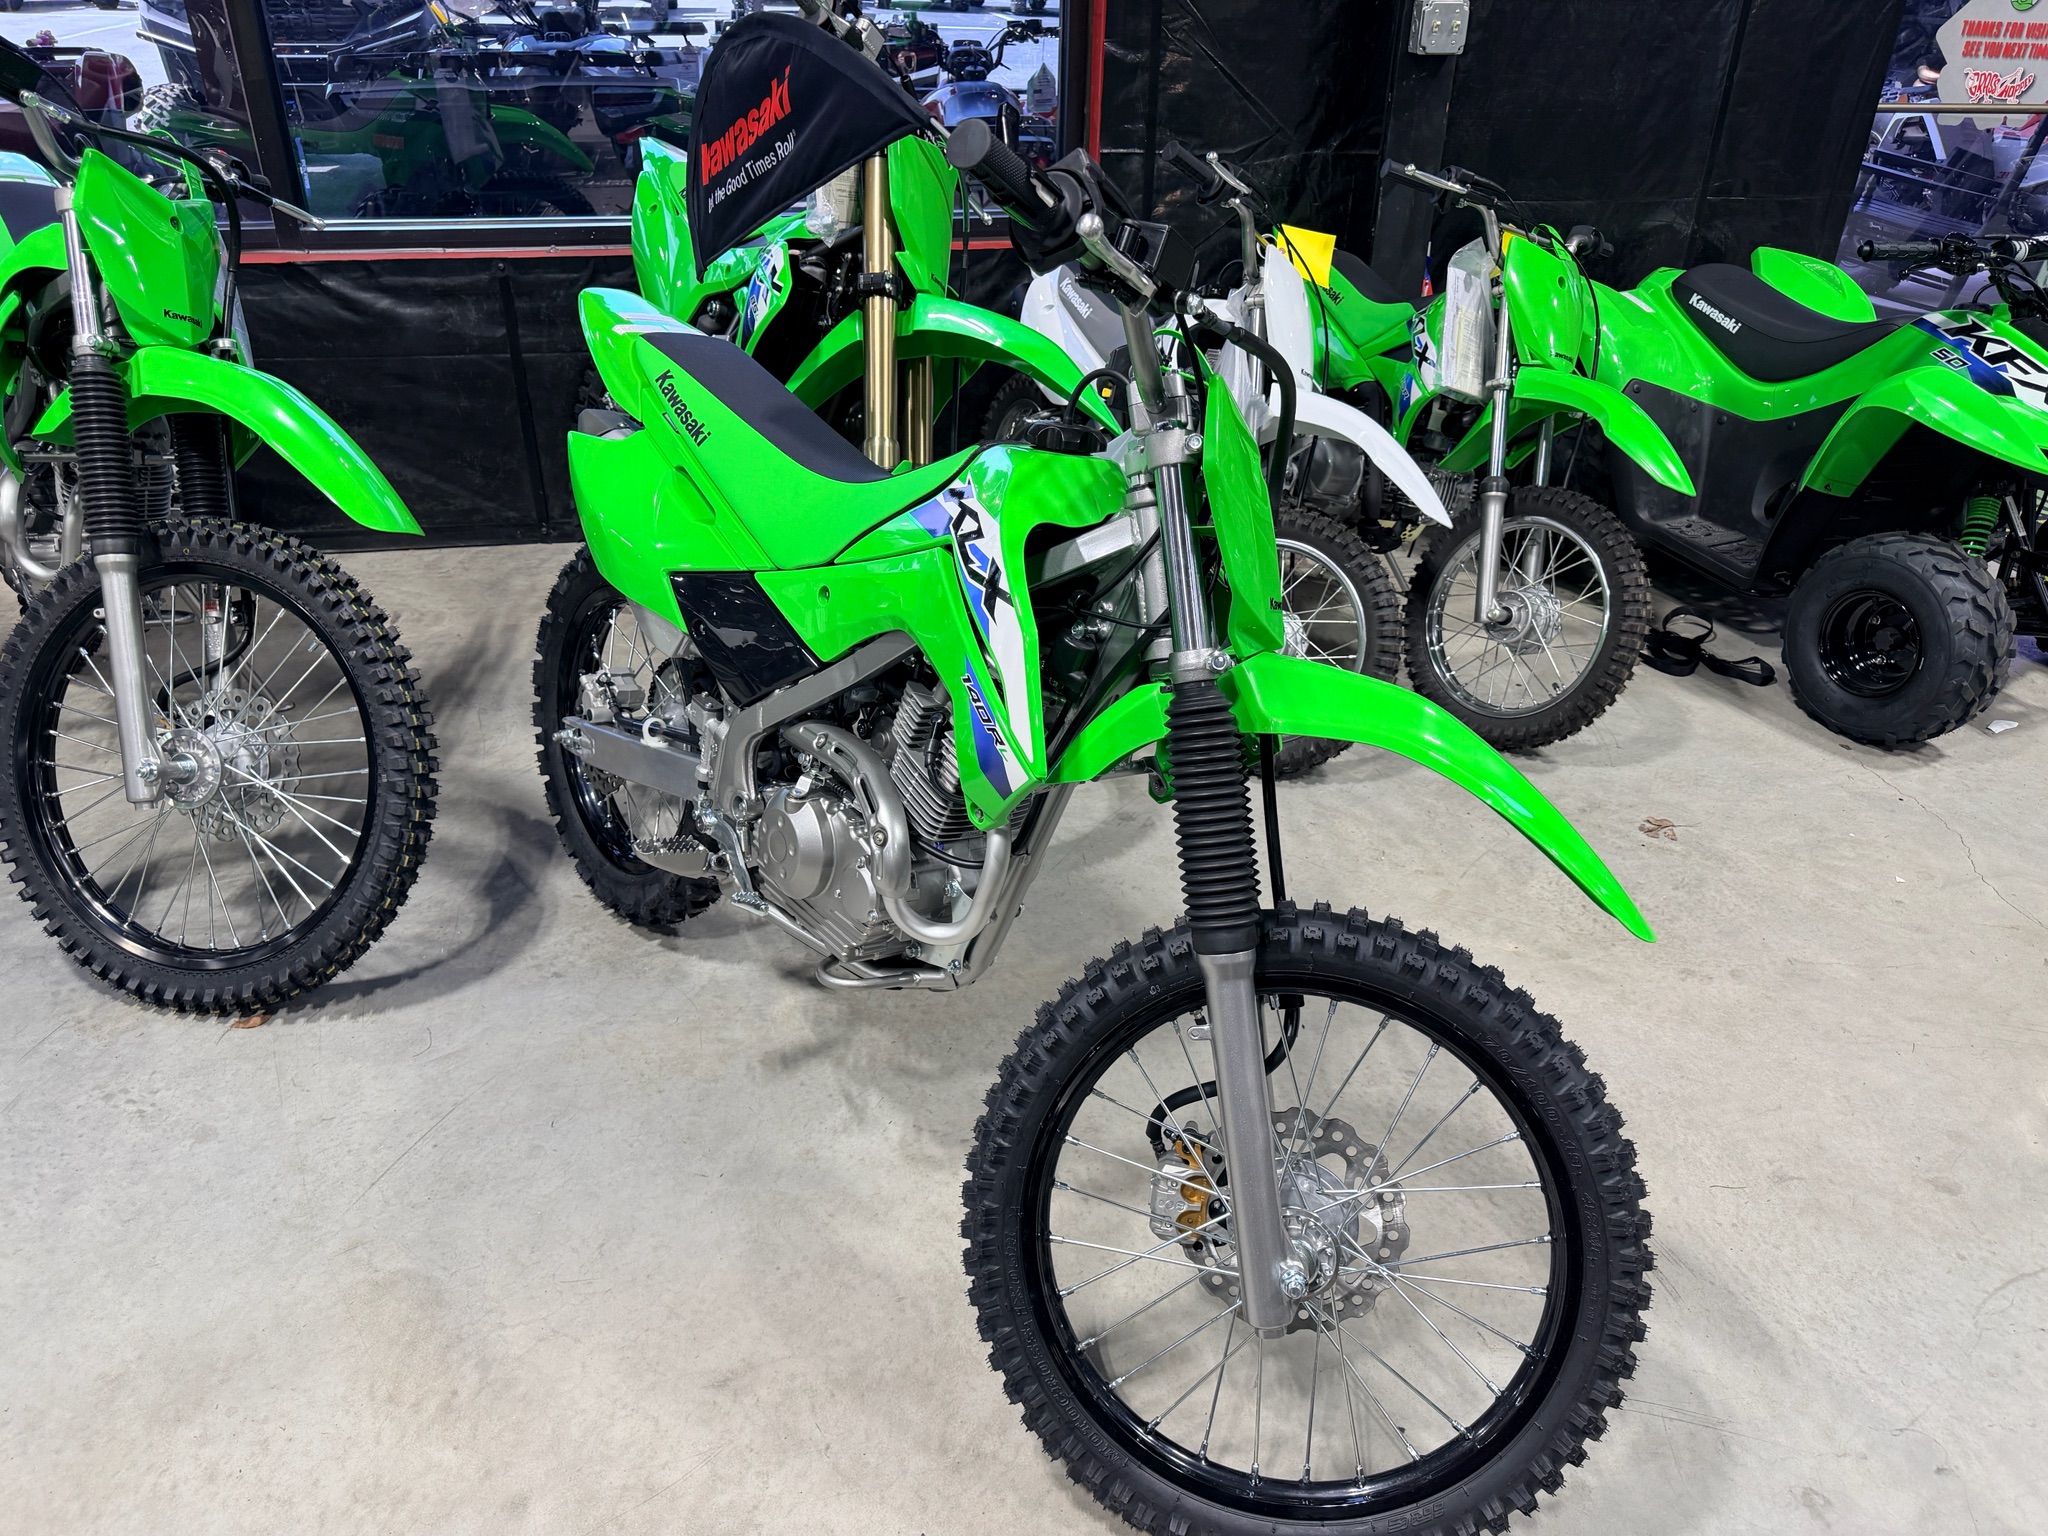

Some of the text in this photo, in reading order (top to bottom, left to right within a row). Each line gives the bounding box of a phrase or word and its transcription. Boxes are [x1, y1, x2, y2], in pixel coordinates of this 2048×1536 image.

[1961, 20, 2002, 37] THANKS
[2002, 21, 2024, 38] FOR
[1962, 41, 2048, 60] SEE YOU NEXT TIM
[715, 184, 726, 205] the
[725, 167, 748, 192] Good
[745, 152, 777, 179] Times
[1059, 276, 1093, 319] Kawasaki
[1689, 292, 1742, 334] Kawasaki
[1930, 347, 1971, 370] 50
[655, 368, 712, 447] Kawasaki
[942, 473, 1015, 626] KLX
